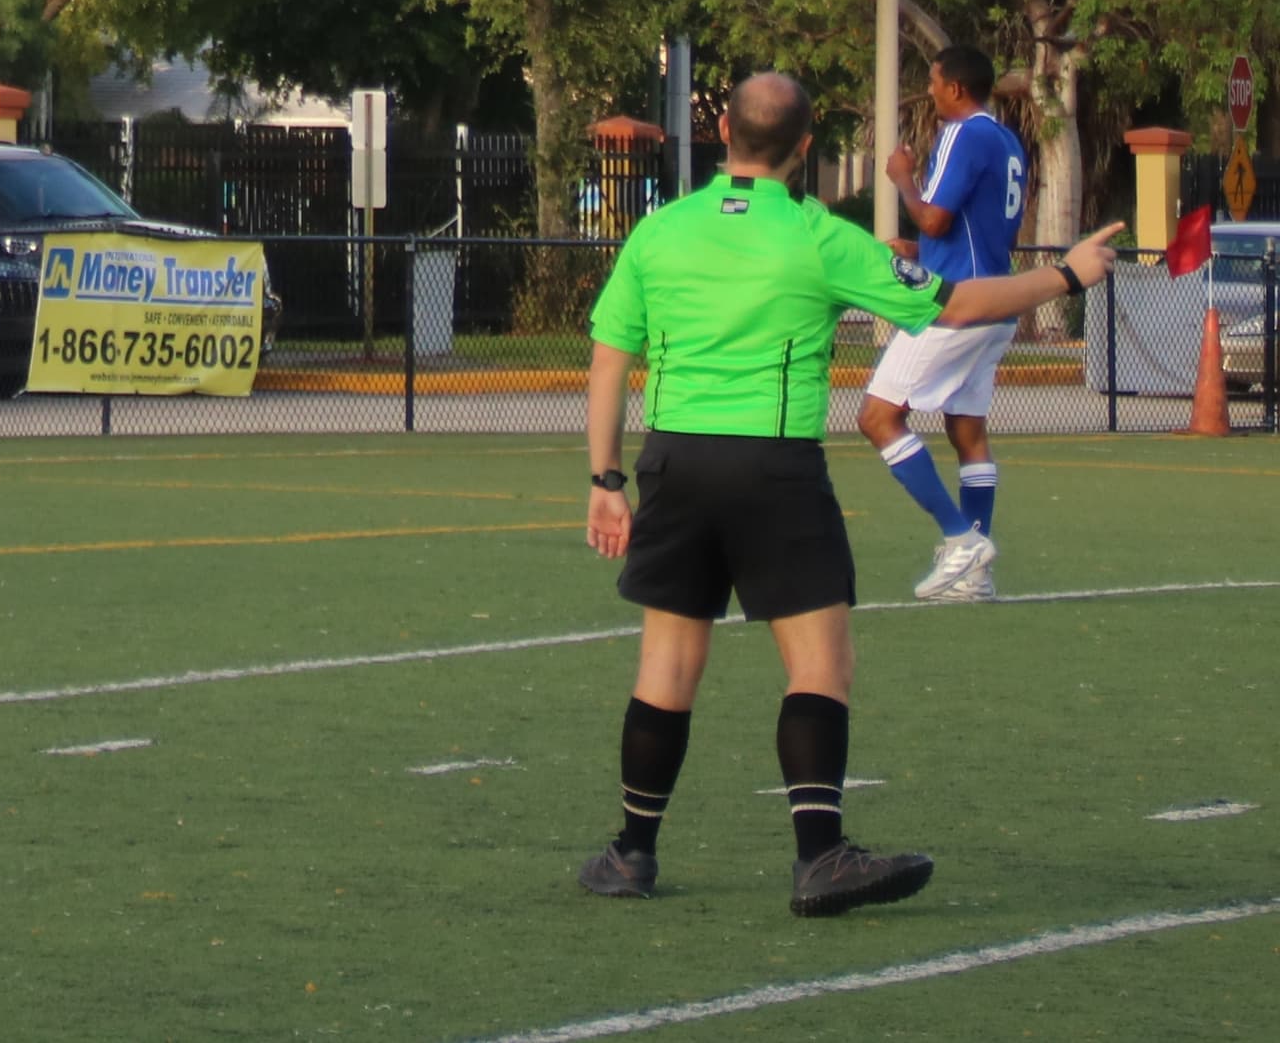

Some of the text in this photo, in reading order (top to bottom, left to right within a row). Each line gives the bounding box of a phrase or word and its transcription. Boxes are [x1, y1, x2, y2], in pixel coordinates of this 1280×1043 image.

[1231, 79, 1251, 107] STOP
[1005, 156, 1023, 220] 6
[77, 252, 257, 302] Money Transfer
[144, 311, 162, 325] SAFE
